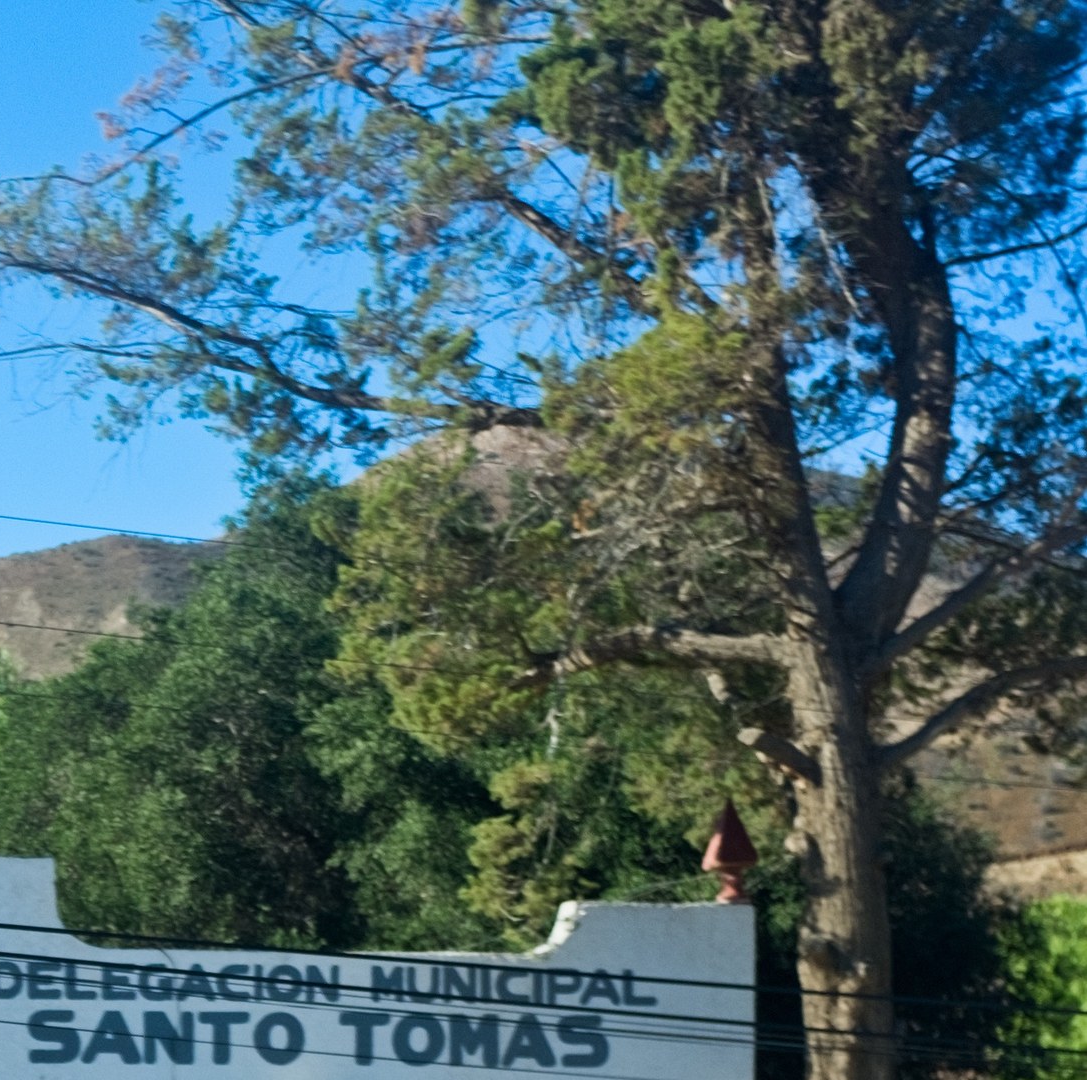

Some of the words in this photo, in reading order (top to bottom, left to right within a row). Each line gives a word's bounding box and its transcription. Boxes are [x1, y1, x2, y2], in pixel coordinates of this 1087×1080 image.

[370, 963, 660, 1006] MUNICIPAL
[28, 1009, 306, 1066] SANTO
[339, 1011, 612, 1068] TOMAS
